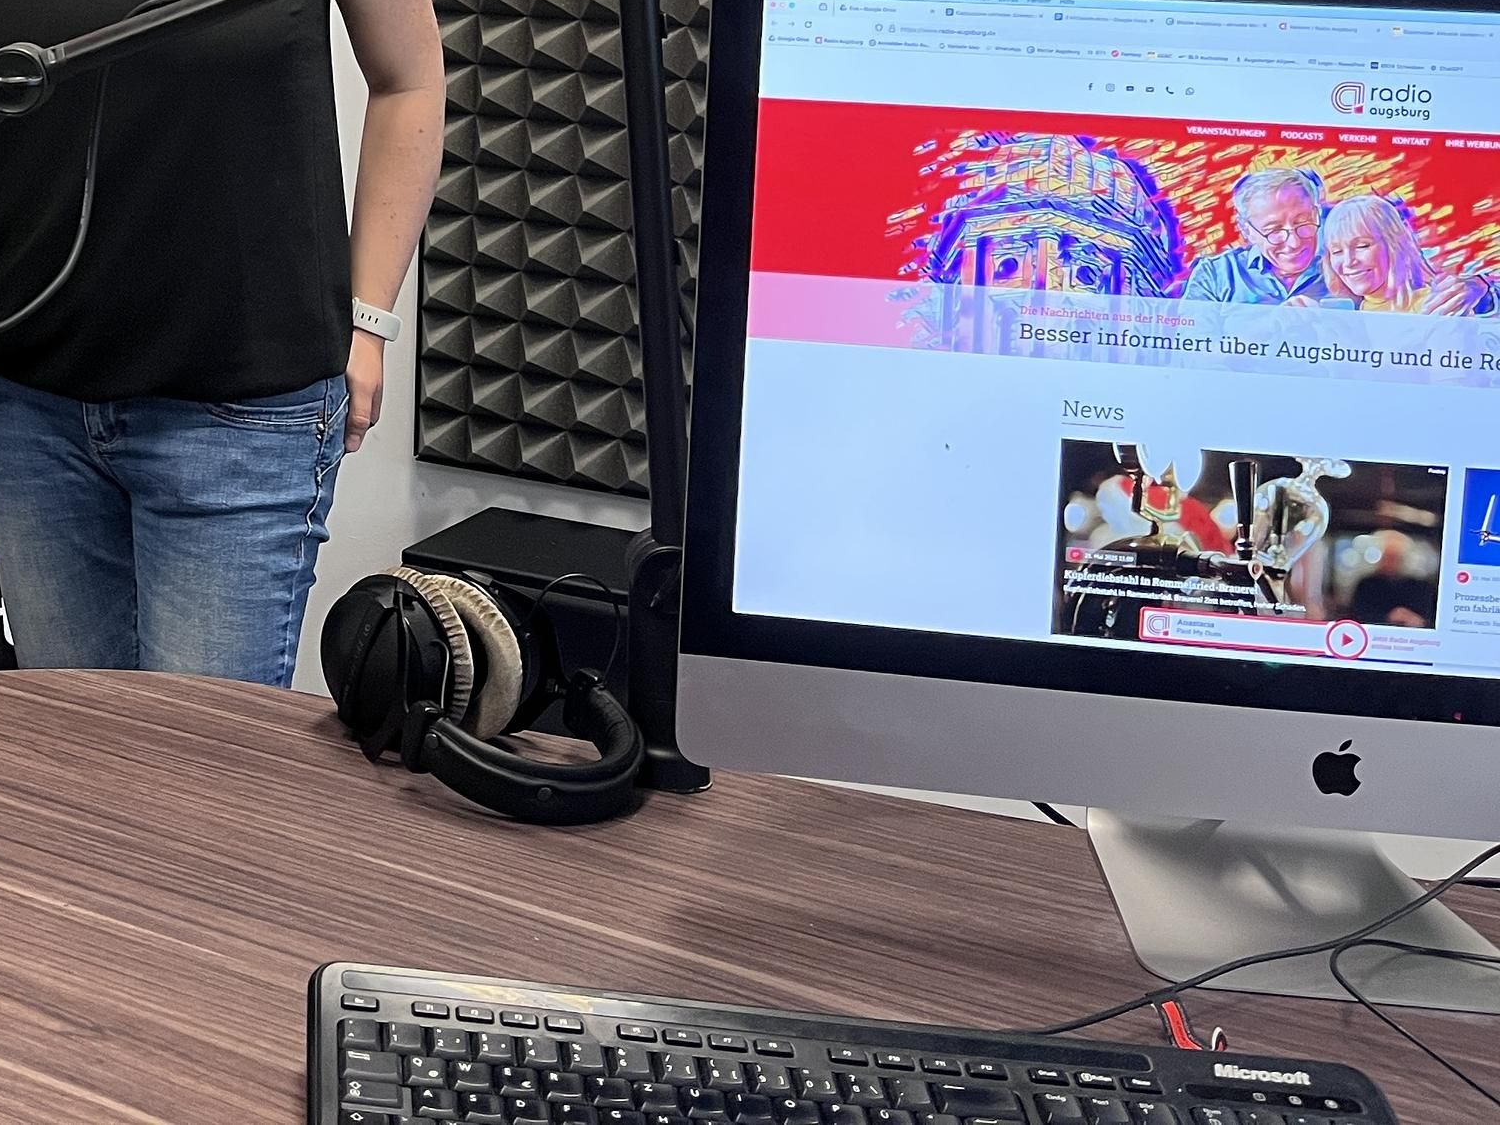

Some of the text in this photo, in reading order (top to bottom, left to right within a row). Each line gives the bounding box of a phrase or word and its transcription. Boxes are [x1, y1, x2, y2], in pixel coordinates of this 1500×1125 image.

[1370, 84, 1432, 103] radio
[1370, 106, 1430, 120] augsburg
[1186, 126, 1266, 137] VERANSTALTUNGEN
[1280, 131, 1323, 140] PODCASTS
[1338, 134, 1377, 143] VERKEHR
[1392, 136, 1431, 146] KONTAKT
[1020, 305, 1195, 328] Die Nachrichten aus der Region
[1019, 323, 1091, 344] Besser
[1097, 327, 1212, 353] informiert
[1219, 335, 1269, 358] über
[1275, 340, 1382, 368] Augsburg
[1390, 347, 1432, 368] und
[1439, 349, 1473, 370] die
[1062, 400, 1124, 421] News
[1064, 570, 1139, 585] Kupferdiebstahl
[1140, 576, 1151, 586] in
[1214, 1063, 1311, 1086] Microsoft
